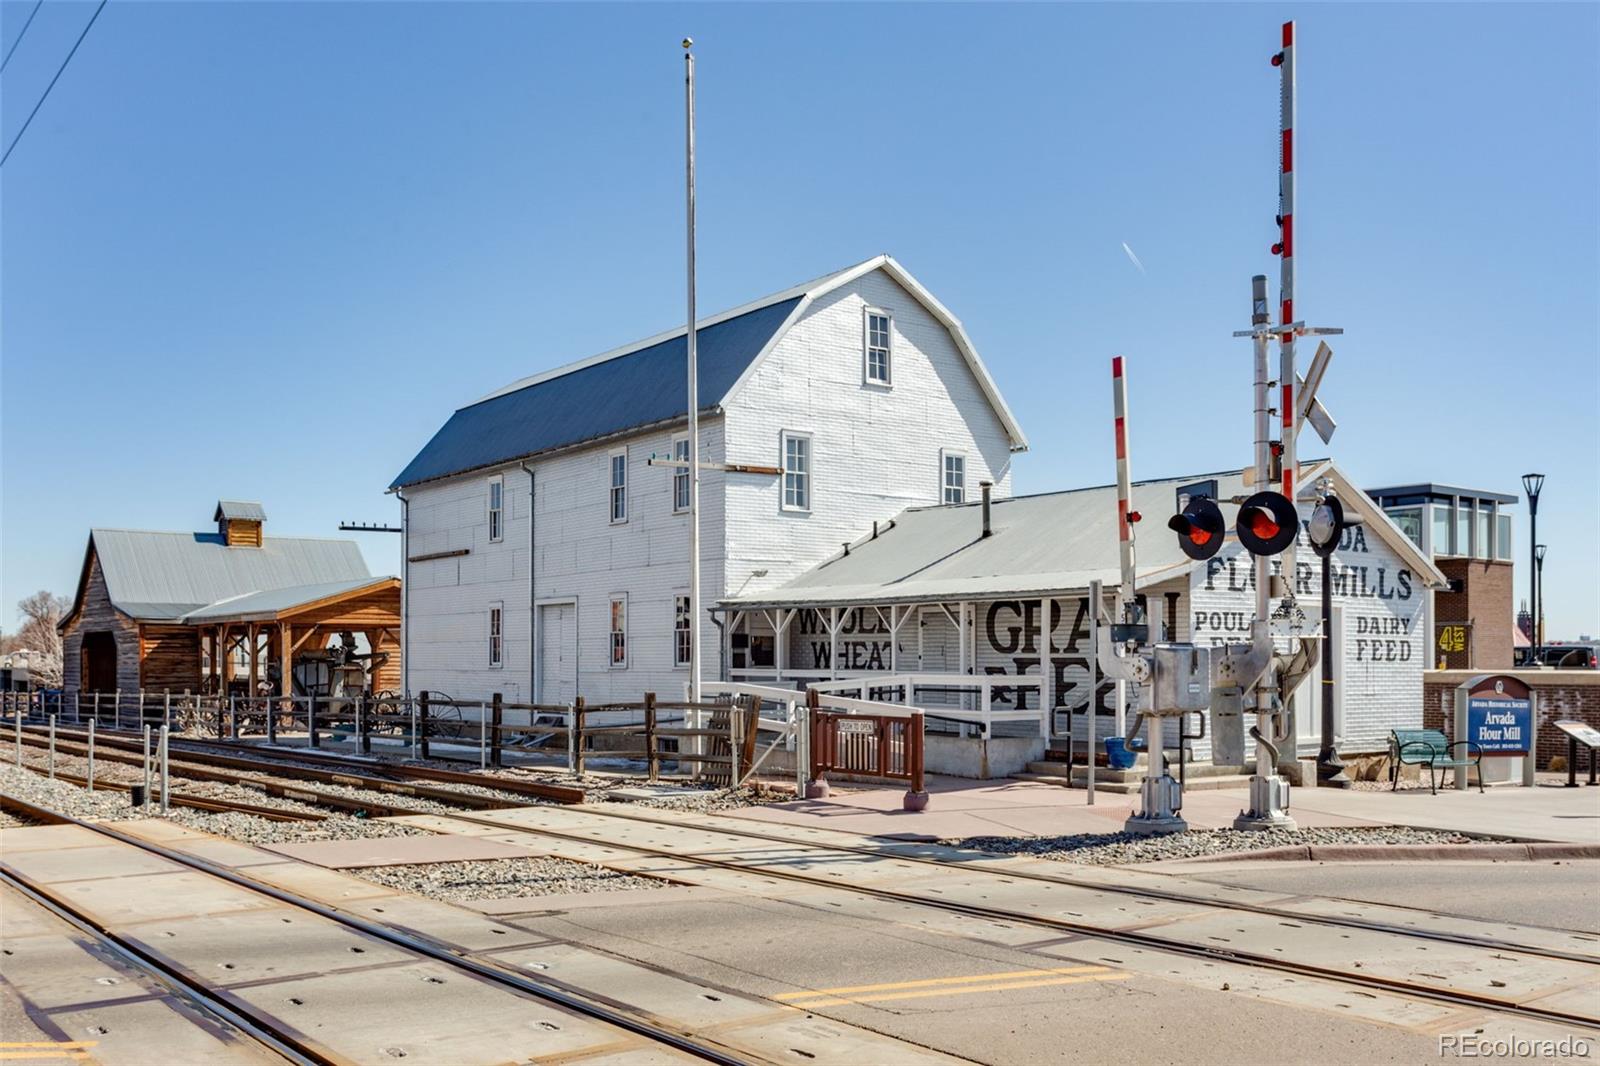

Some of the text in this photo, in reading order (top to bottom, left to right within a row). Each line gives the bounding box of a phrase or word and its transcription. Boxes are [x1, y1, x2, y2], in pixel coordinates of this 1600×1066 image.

[1205, 557, 1412, 600] FLR MILLS
[1194, 611, 1257, 631] POUL
[1357, 616, 1410, 635] DAIRY
[1453, 626, 1464, 651] WEST
[1356, 639, 1412, 662] FEED
[1484, 711, 1515, 725] Arvada
[1479, 726, 1521, 740] Flour Mill
